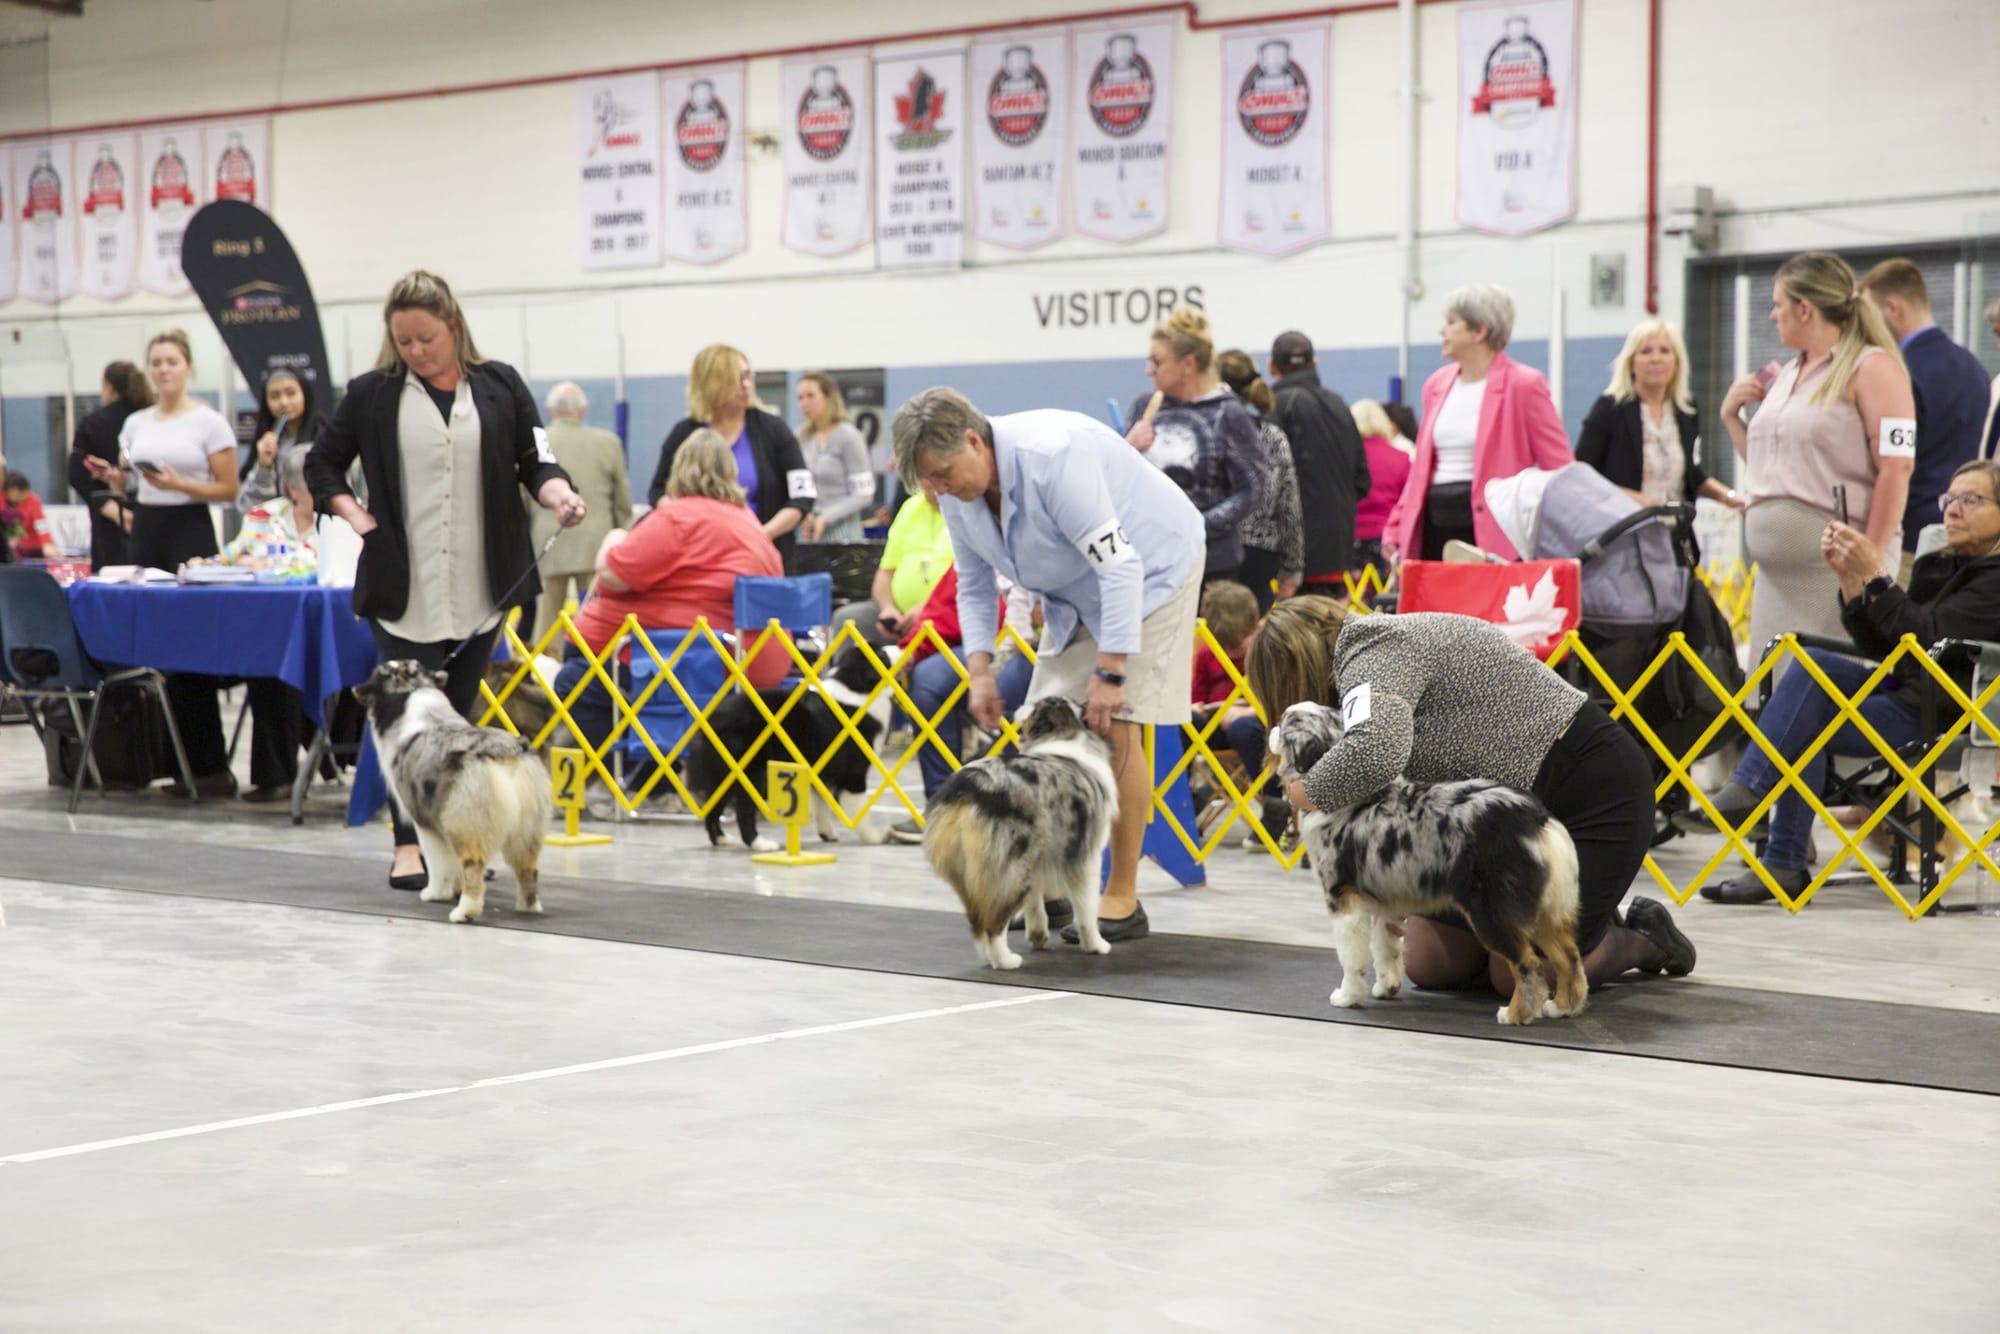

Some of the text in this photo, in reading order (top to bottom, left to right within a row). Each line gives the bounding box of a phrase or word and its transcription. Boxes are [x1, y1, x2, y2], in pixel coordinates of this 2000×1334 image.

[1033, 286, 1204, 329] VISITORS
[558, 756, 575, 800] 2
[777, 770, 798, 817] 3
